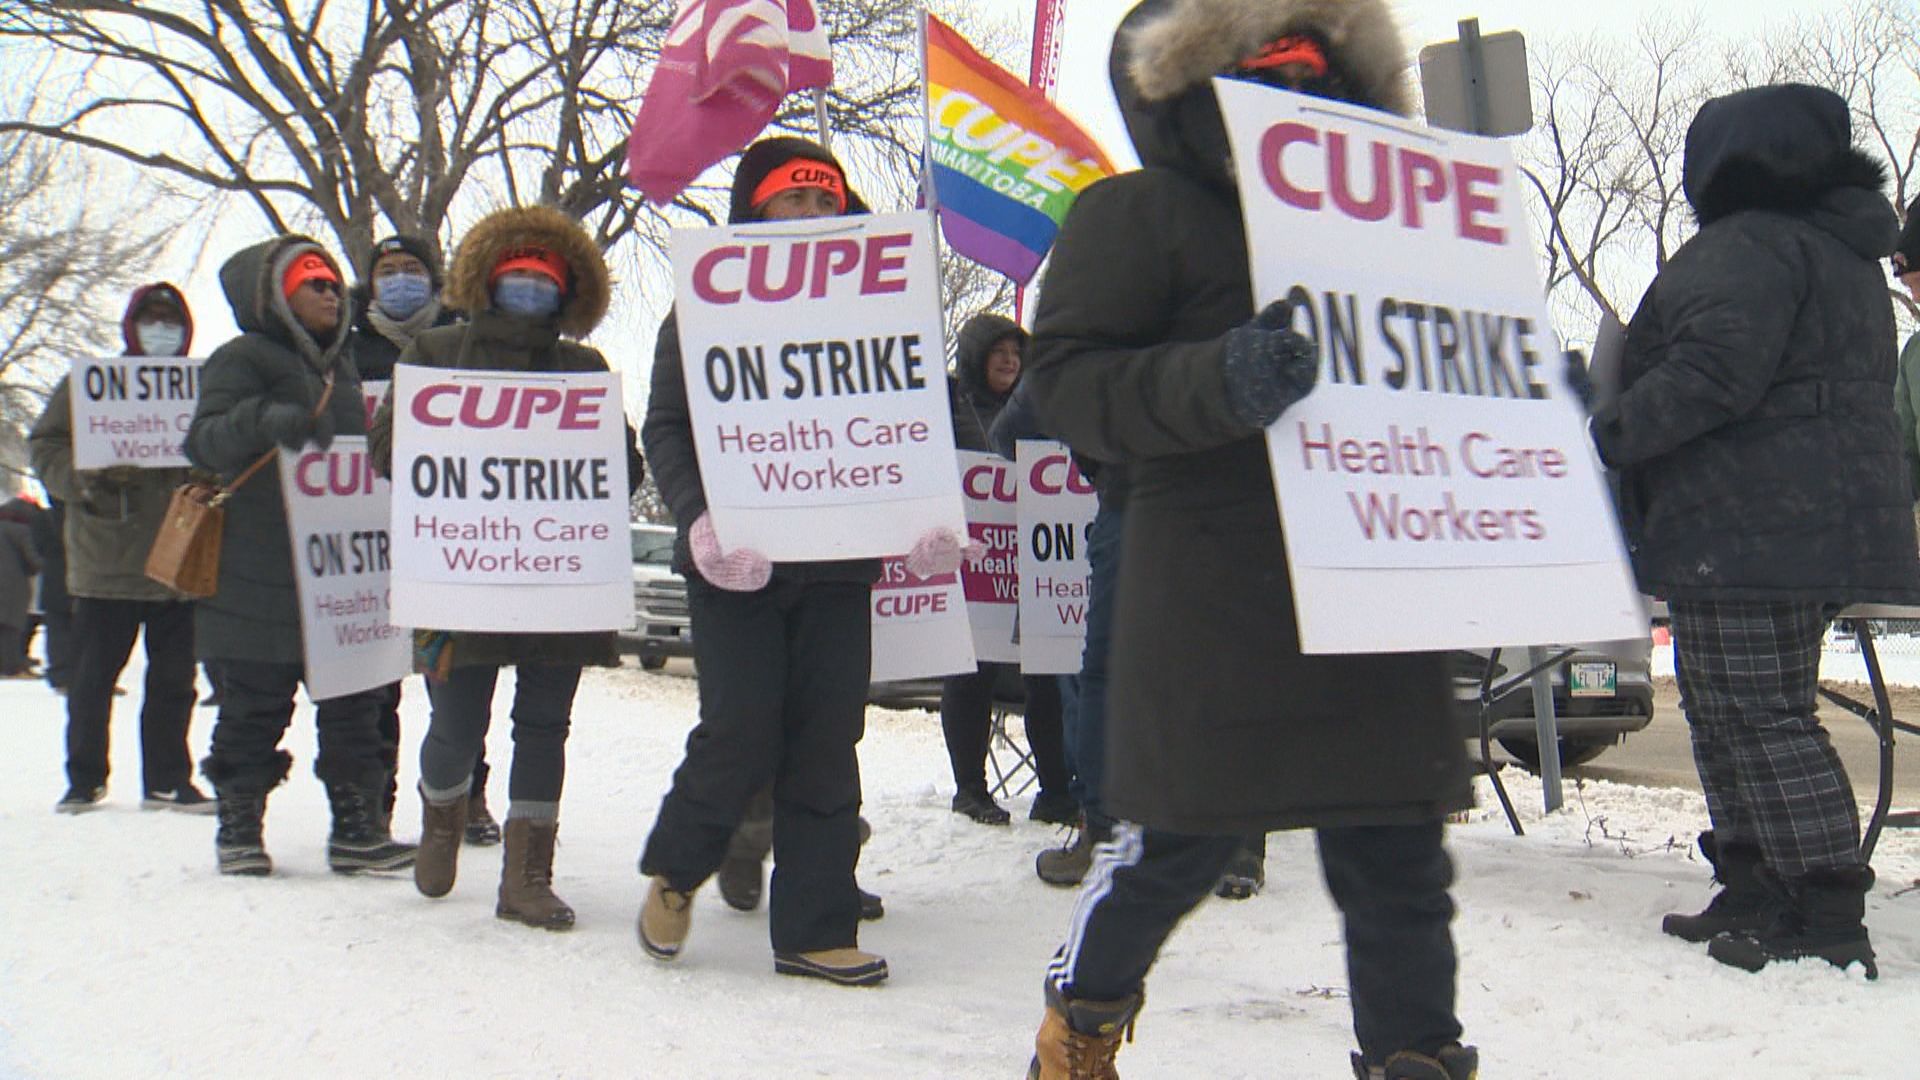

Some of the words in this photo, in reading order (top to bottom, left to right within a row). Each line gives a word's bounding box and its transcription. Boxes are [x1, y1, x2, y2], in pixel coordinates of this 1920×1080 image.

[931, 89, 1098, 193] CUPE
[791, 168, 837, 187] CUPE
[1258, 121, 1508, 245] CUPE
[692, 233, 913, 304] CUPE
[705, 345, 768, 402] ON
[781, 334, 926, 400] STRIKE
[1378, 297, 1552, 400] STRIKE
[85, 365, 128, 401] ON
[88, 413, 168, 434] Health
[411, 384, 608, 430] CUPE
[717, 419, 833, 453] Health
[847, 416, 929, 448] Care
[1296, 421, 1450, 477] Health
[1460, 432, 1568, 479] Care
[411, 455, 467, 499] ON
[481, 457, 610, 500] STRIKE
[752, 458, 904, 492] Workers
[414, 515, 521, 541] Health
[534, 518, 609, 542] Care
[1346, 491, 1548, 541] Workers
[307, 533, 345, 577] ON
[443, 547, 581, 572] Workers
[1032, 523, 1075, 561] ON
[315, 588, 379, 616] Health
[876, 593, 947, 617] CUPE
